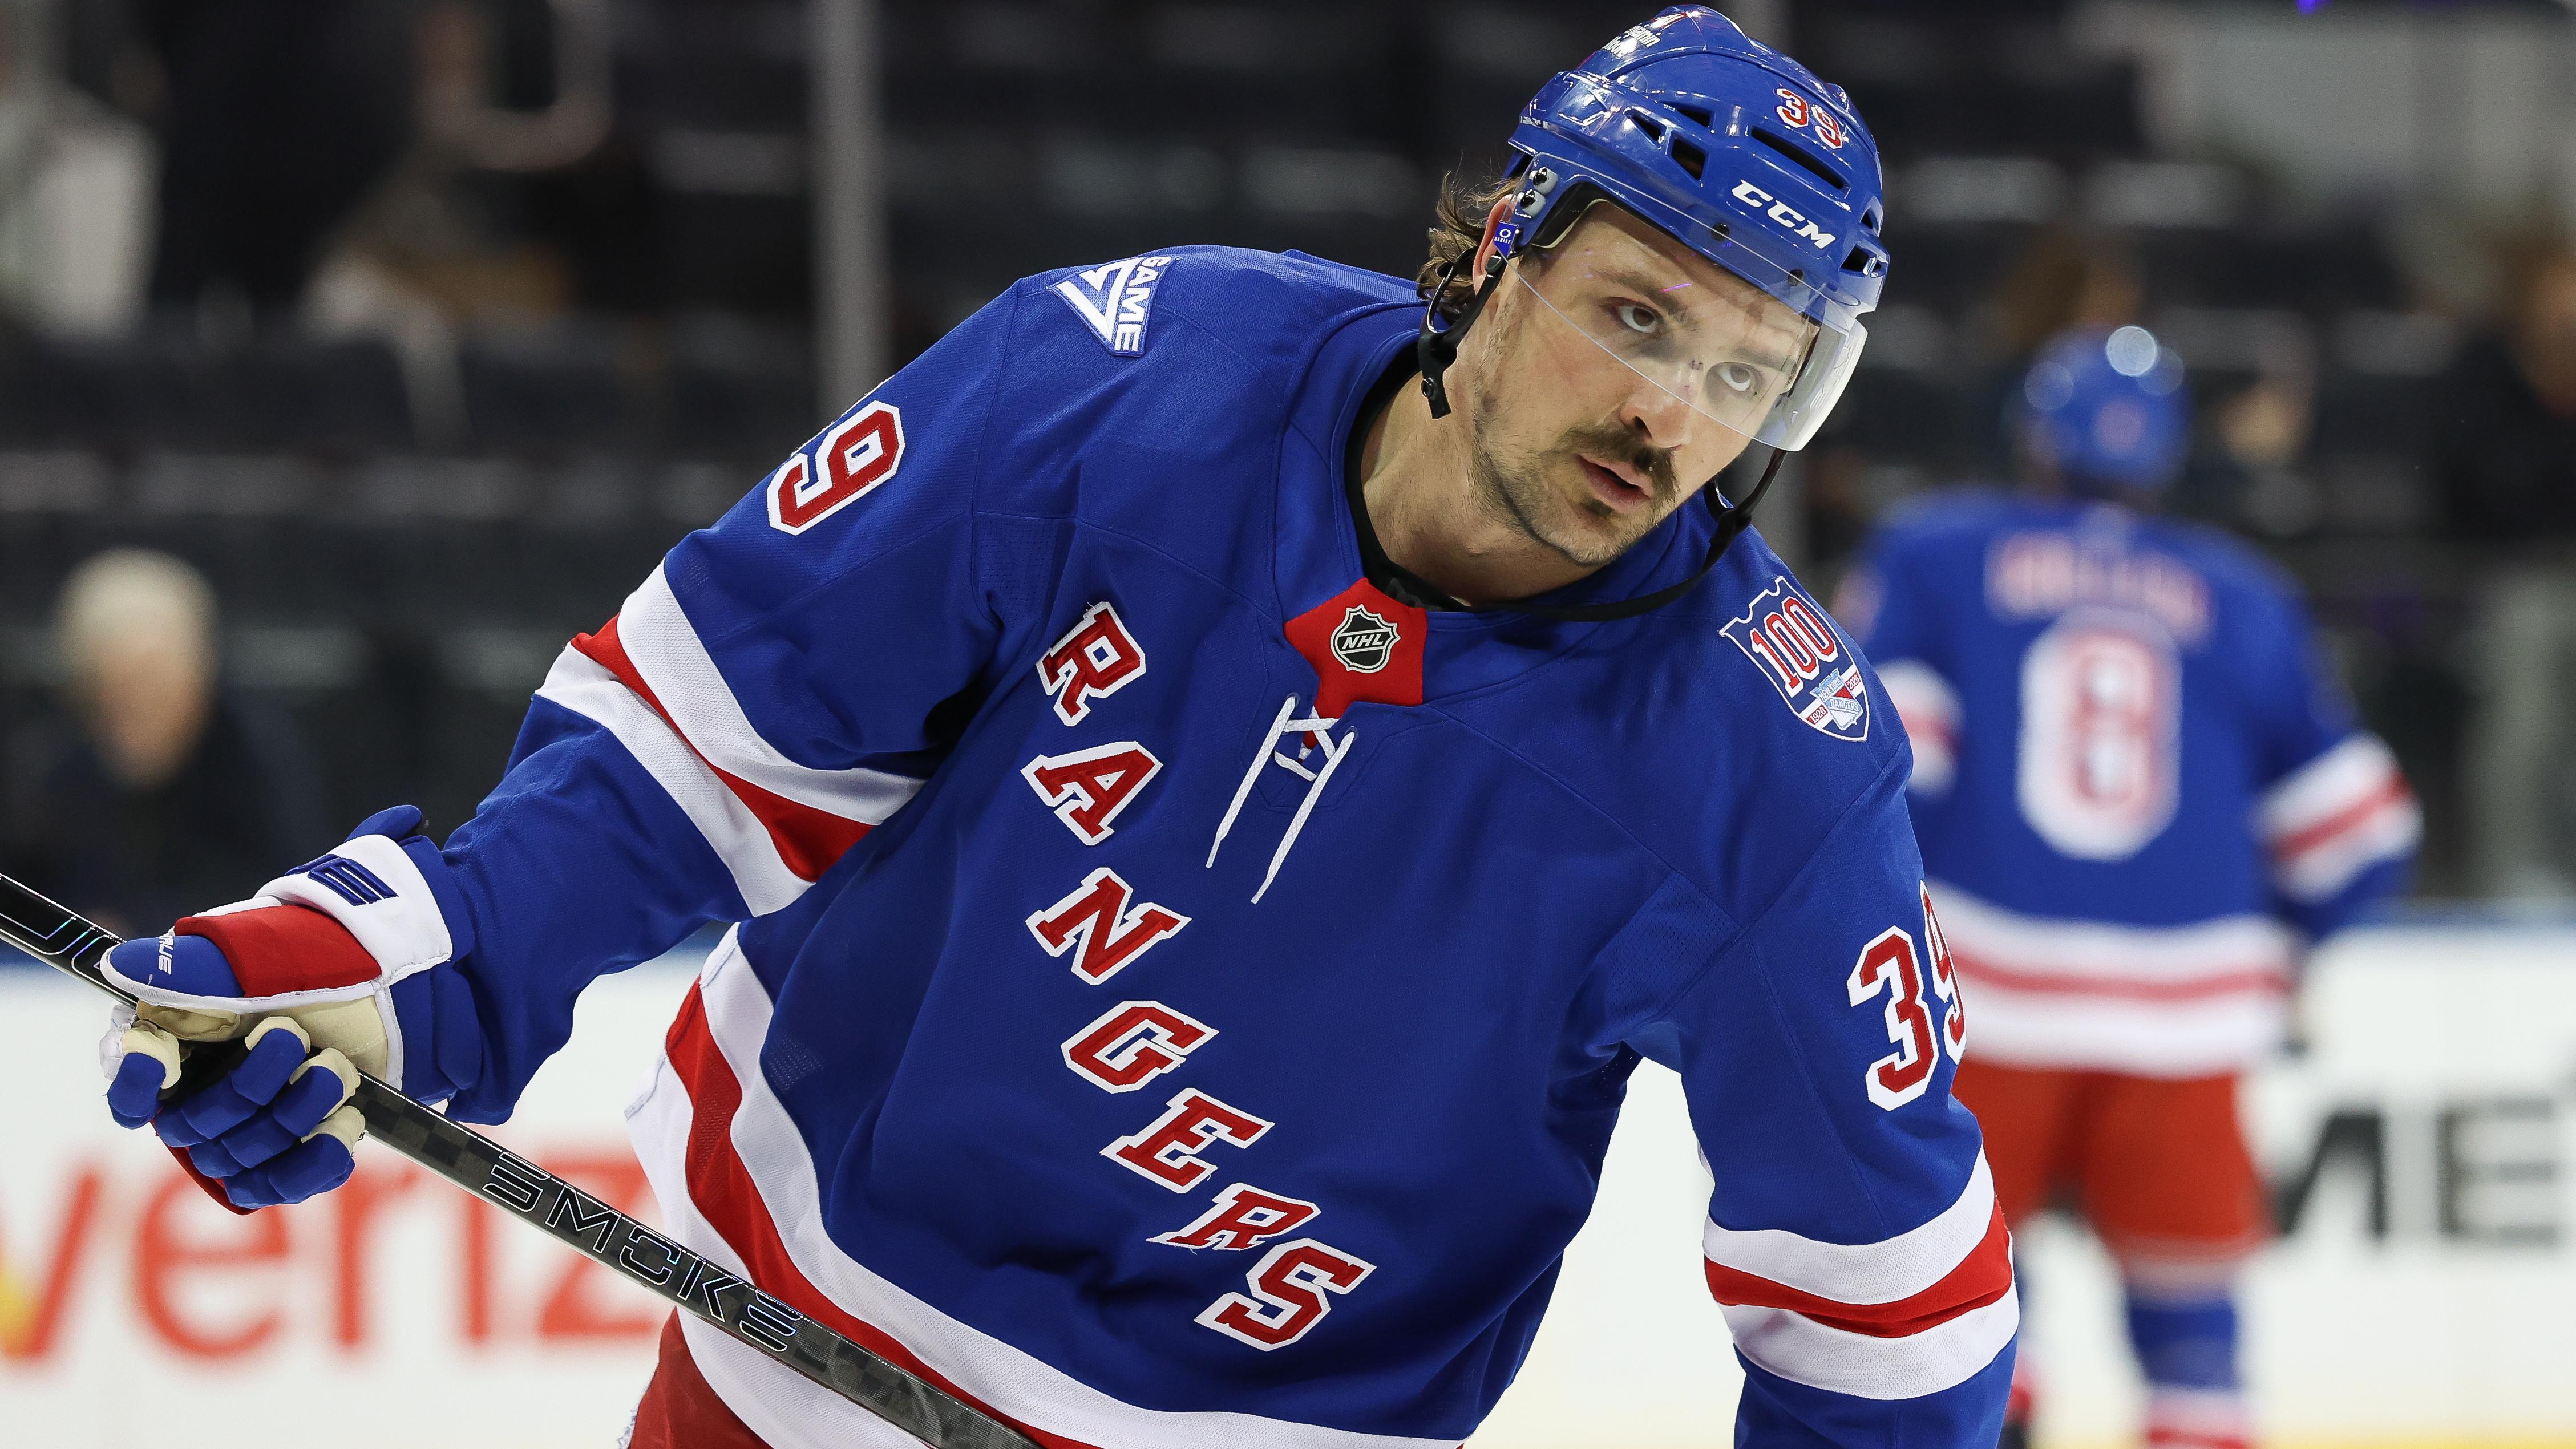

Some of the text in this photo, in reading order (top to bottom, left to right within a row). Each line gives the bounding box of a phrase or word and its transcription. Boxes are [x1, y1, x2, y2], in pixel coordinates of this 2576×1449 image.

[1776, 88, 1842, 149] 39
[1732, 179, 1836, 249] CCM
[1113, 256, 1172, 351] GAME
[767, 400, 906, 536] 9
[1341, 633, 1384, 650] NHL
[1750, 596, 1839, 698] 100
[1810, 706, 1826, 723] 1926
[1818, 677, 1843, 701] NEW YORK
[1829, 698, 1859, 711] RANGERS
[2017, 606, 2183, 860] 8
[158, 933, 174, 975] RUE
[1020, 601, 1377, 1352] RANGERS
[1846, 879, 1968, 1112] 39
[482, 1151, 804, 1353] SMOKE
